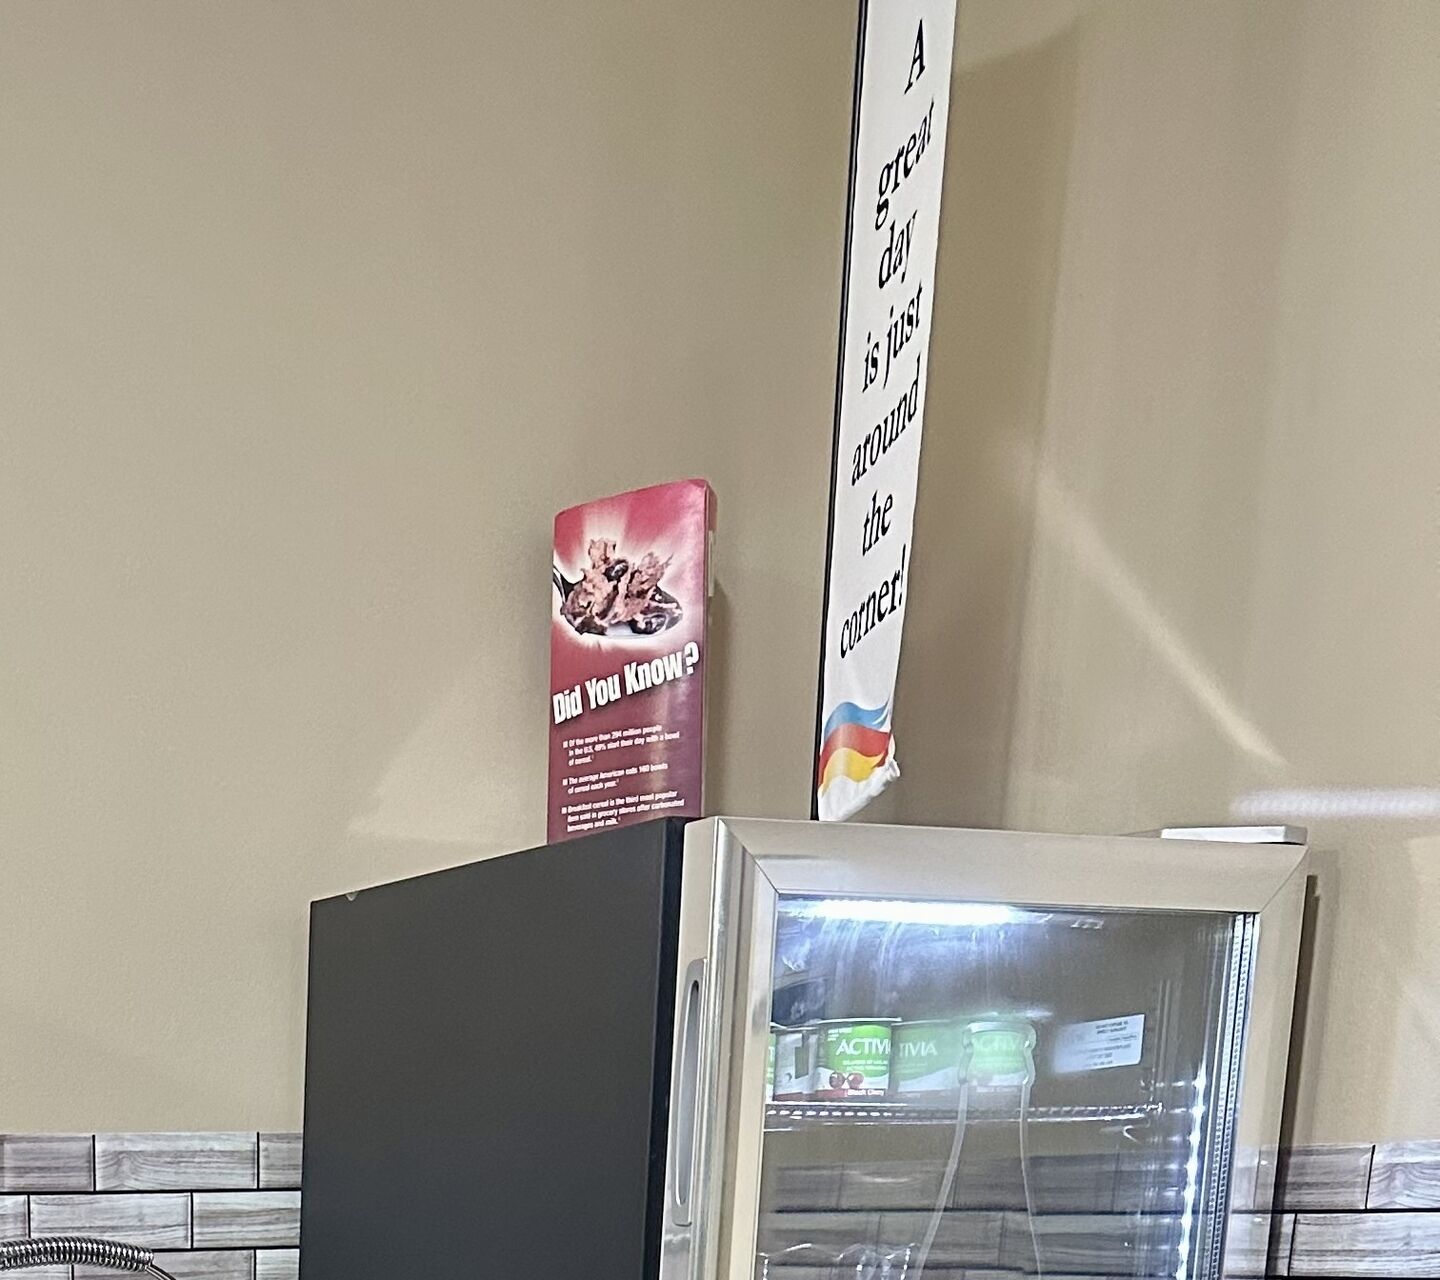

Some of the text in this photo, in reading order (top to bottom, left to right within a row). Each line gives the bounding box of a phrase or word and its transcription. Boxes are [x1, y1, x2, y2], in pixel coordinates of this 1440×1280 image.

[904, 18, 925, 95] A
[875, 97, 934, 230] great
[879, 210, 918, 289] day
[862, 279, 923, 392] is just
[851, 352, 921, 486] around
[862, 490, 893, 556] the
[840, 543, 907, 659] corner!
[552, 641, 700, 725] Did You Know?
[836, 1038, 891, 1055] ACTIV
[899, 1041, 939, 1057] TIVIA
